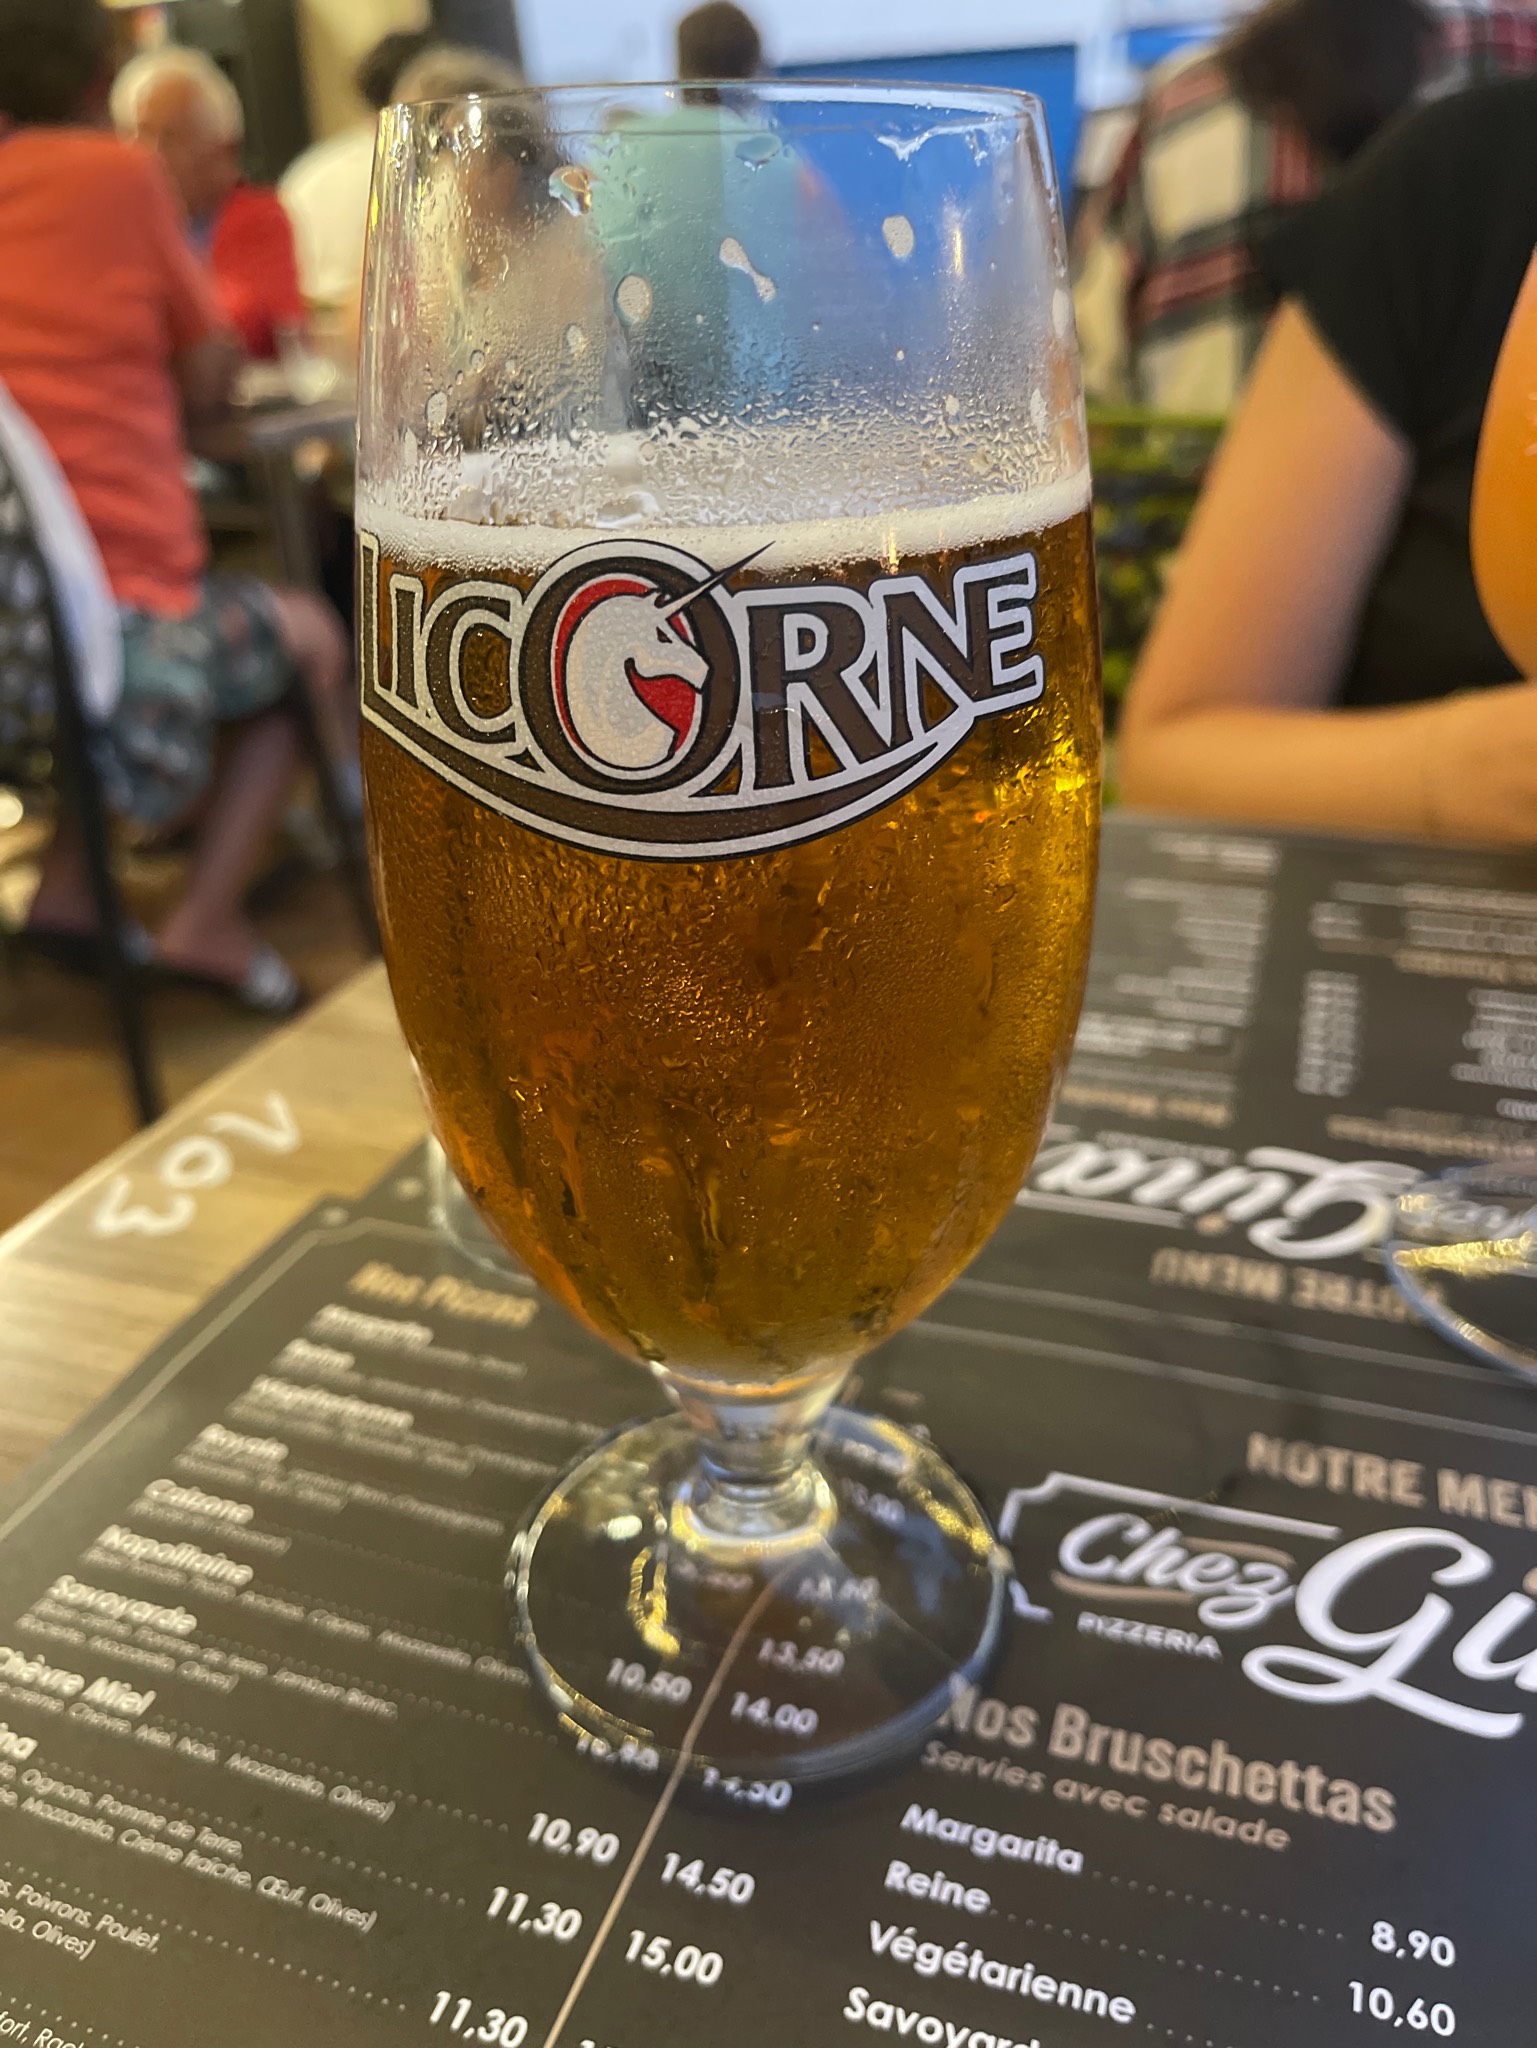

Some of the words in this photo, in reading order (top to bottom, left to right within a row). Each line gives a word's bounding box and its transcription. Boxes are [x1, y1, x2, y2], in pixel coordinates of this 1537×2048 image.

[360, 530, 1047, 862] LICORNE
[1246, 1431, 1427, 1509] NOTRE
[1058, 1512, 1297, 1630] Chez
[1076, 1612, 1222, 1661] PIZZERIA
[81, 1676, 157, 1718] Miel
[920, 1739, 1047, 1793] Servies
[1052, 1776, 1148, 1819] avec
[1157, 1802, 1290, 1852] salade
[1048, 1702, 1397, 1833] Bruschettas
[526, 1812, 621, 1865] 10,90
[659, 1851, 756, 1905] 14,50
[902, 1804, 1084, 1876] Margarita
[1371, 1921, 1457, 1969] 8,90
[32, 1920, 96, 1961] Olives)
[485, 1885, 583, 1942] 11,30
[623, 1929, 724, 1986] 15,00
[95, 1914, 160, 1954] Poulet,
[868, 1920, 1137, 2026] Végétarienne
[884, 1859, 991, 1914] Reine
[1348, 1981, 1458, 2038] 10,60
[428, 1989, 529, 2048] 11,30
